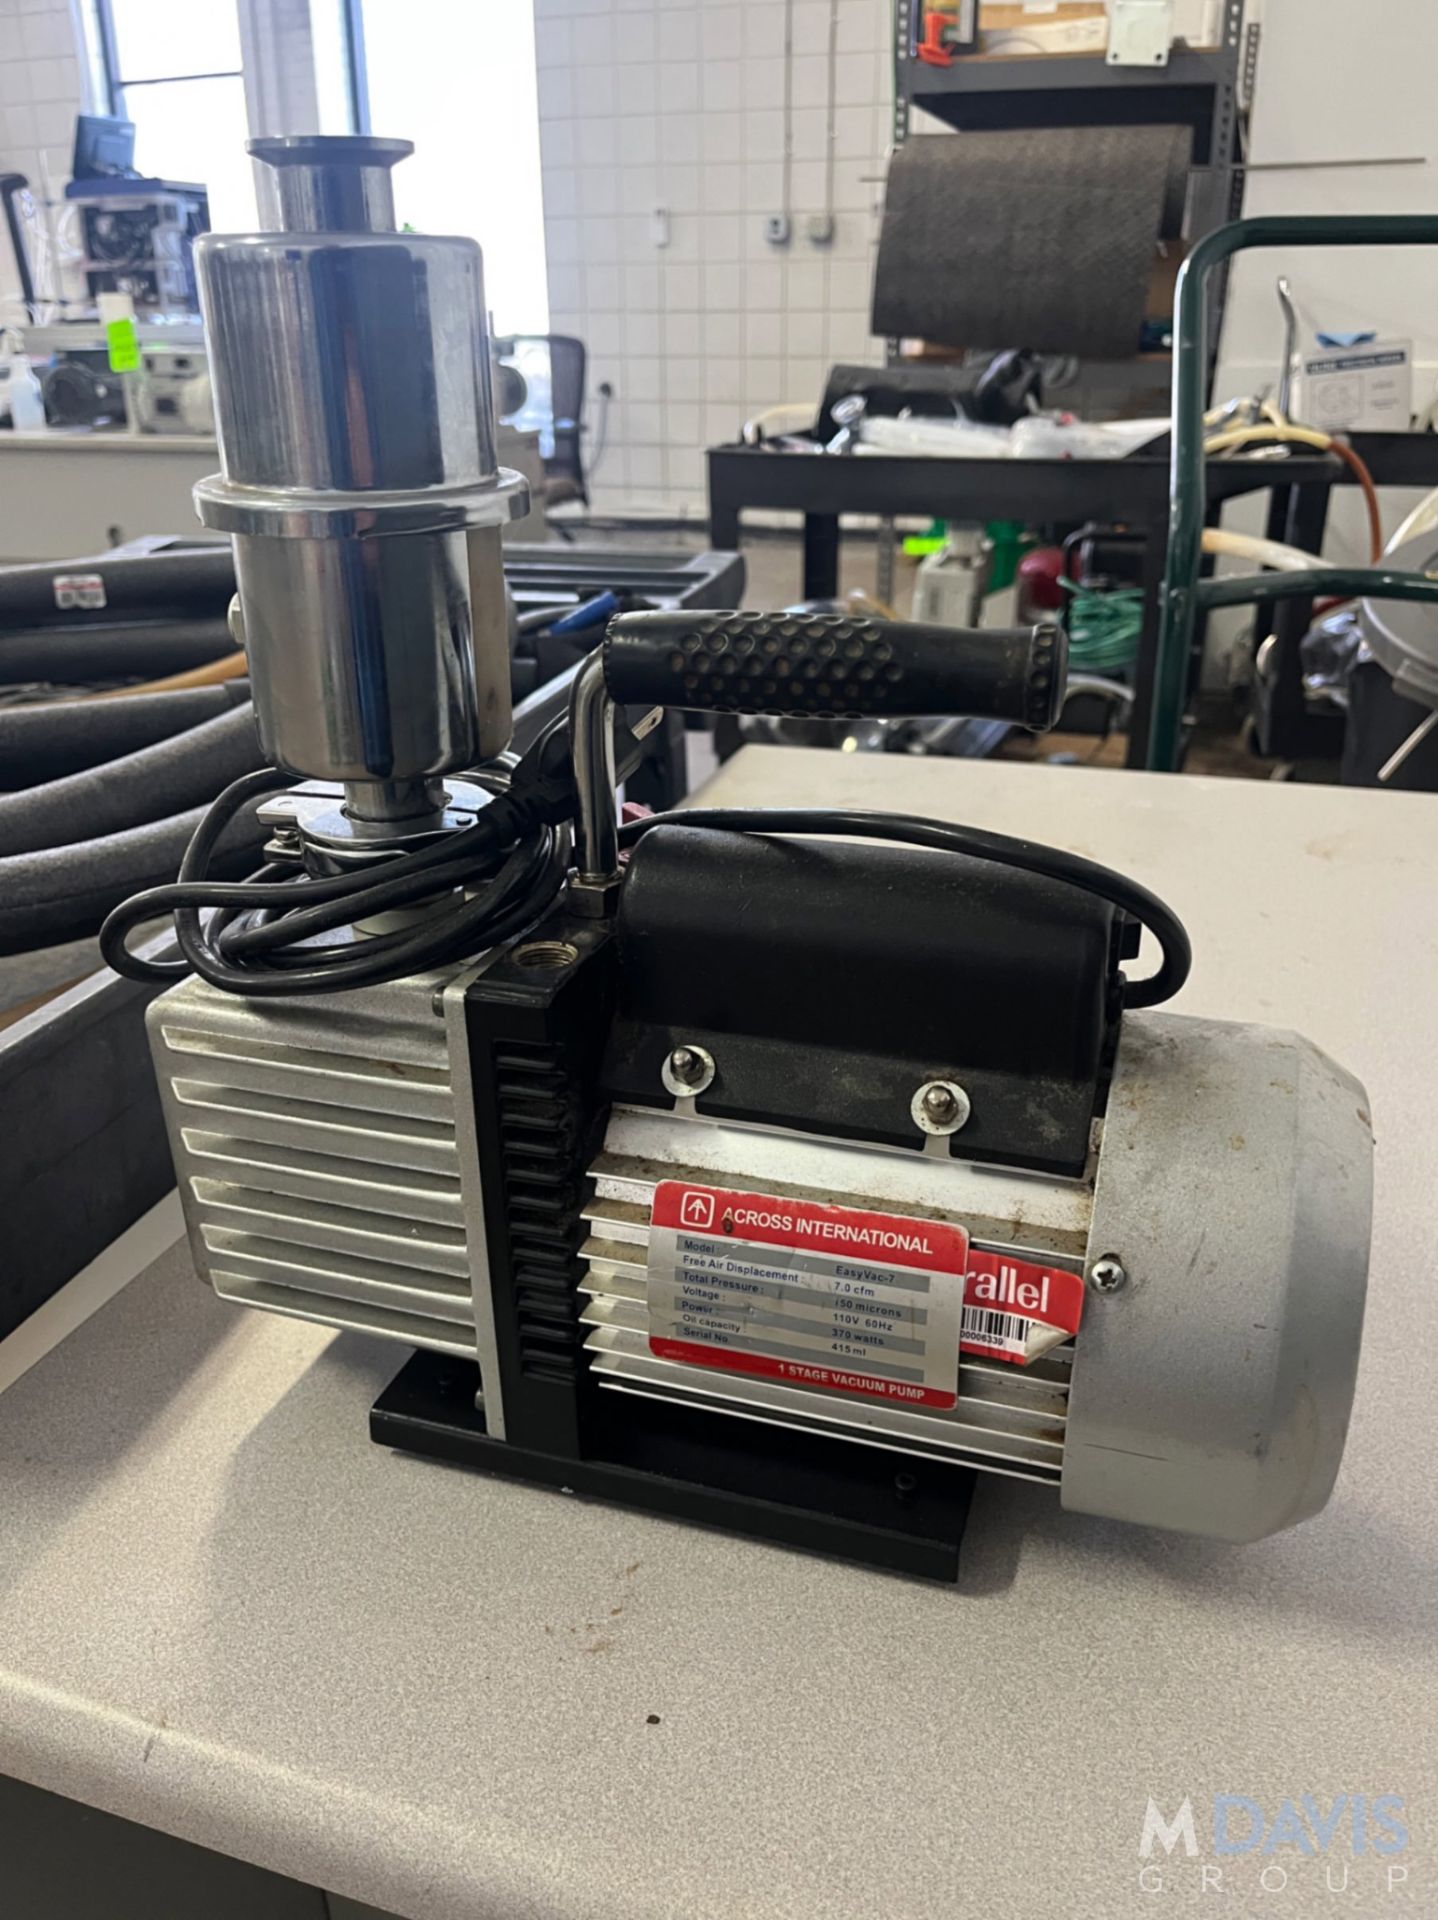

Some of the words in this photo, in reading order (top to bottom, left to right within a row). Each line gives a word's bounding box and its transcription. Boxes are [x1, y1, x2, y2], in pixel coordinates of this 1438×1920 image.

[721, 1207, 793, 1231] ACROSS
[796, 1218, 933, 1254] INTERNATIONAL
[683, 1255, 706, 1267] Free
[708, 1259, 723, 1269] Air
[726, 1262, 798, 1283] Displacement
[835, 1282, 850, 1292] 7.0
[853, 1286, 875, 1297] cfm
[684, 1239, 714, 1252] Model
[835, 1265, 895, 1283] EasyVac-7
[683, 1271, 708, 1284] Total
[711, 1276, 759, 1293] Pressure
[855, 1302, 902, 1318] microns
[683, 1285, 719, 1300] Voltage
[833, 1313, 859, 1325] 110V
[865, 1318, 893, 1331] 60Hz
[682, 1300, 713, 1313] Power
[832, 1328, 851, 1339] 370
[854, 1334, 884, 1346] watts
[683, 1327, 712, 1340] Serial
[683, 1314, 697, 1323] Oil
[699, 1316, 741, 1333] capacity
[832, 1343, 851, 1354] 415
[853, 1348, 866, 1356] ml
[778, 1364, 785, 1373] 1
[789, 1365, 829, 1382] STAGE
[831, 1373, 885, 1393] VACUUM
[888, 1384, 925, 1400] PUMP
